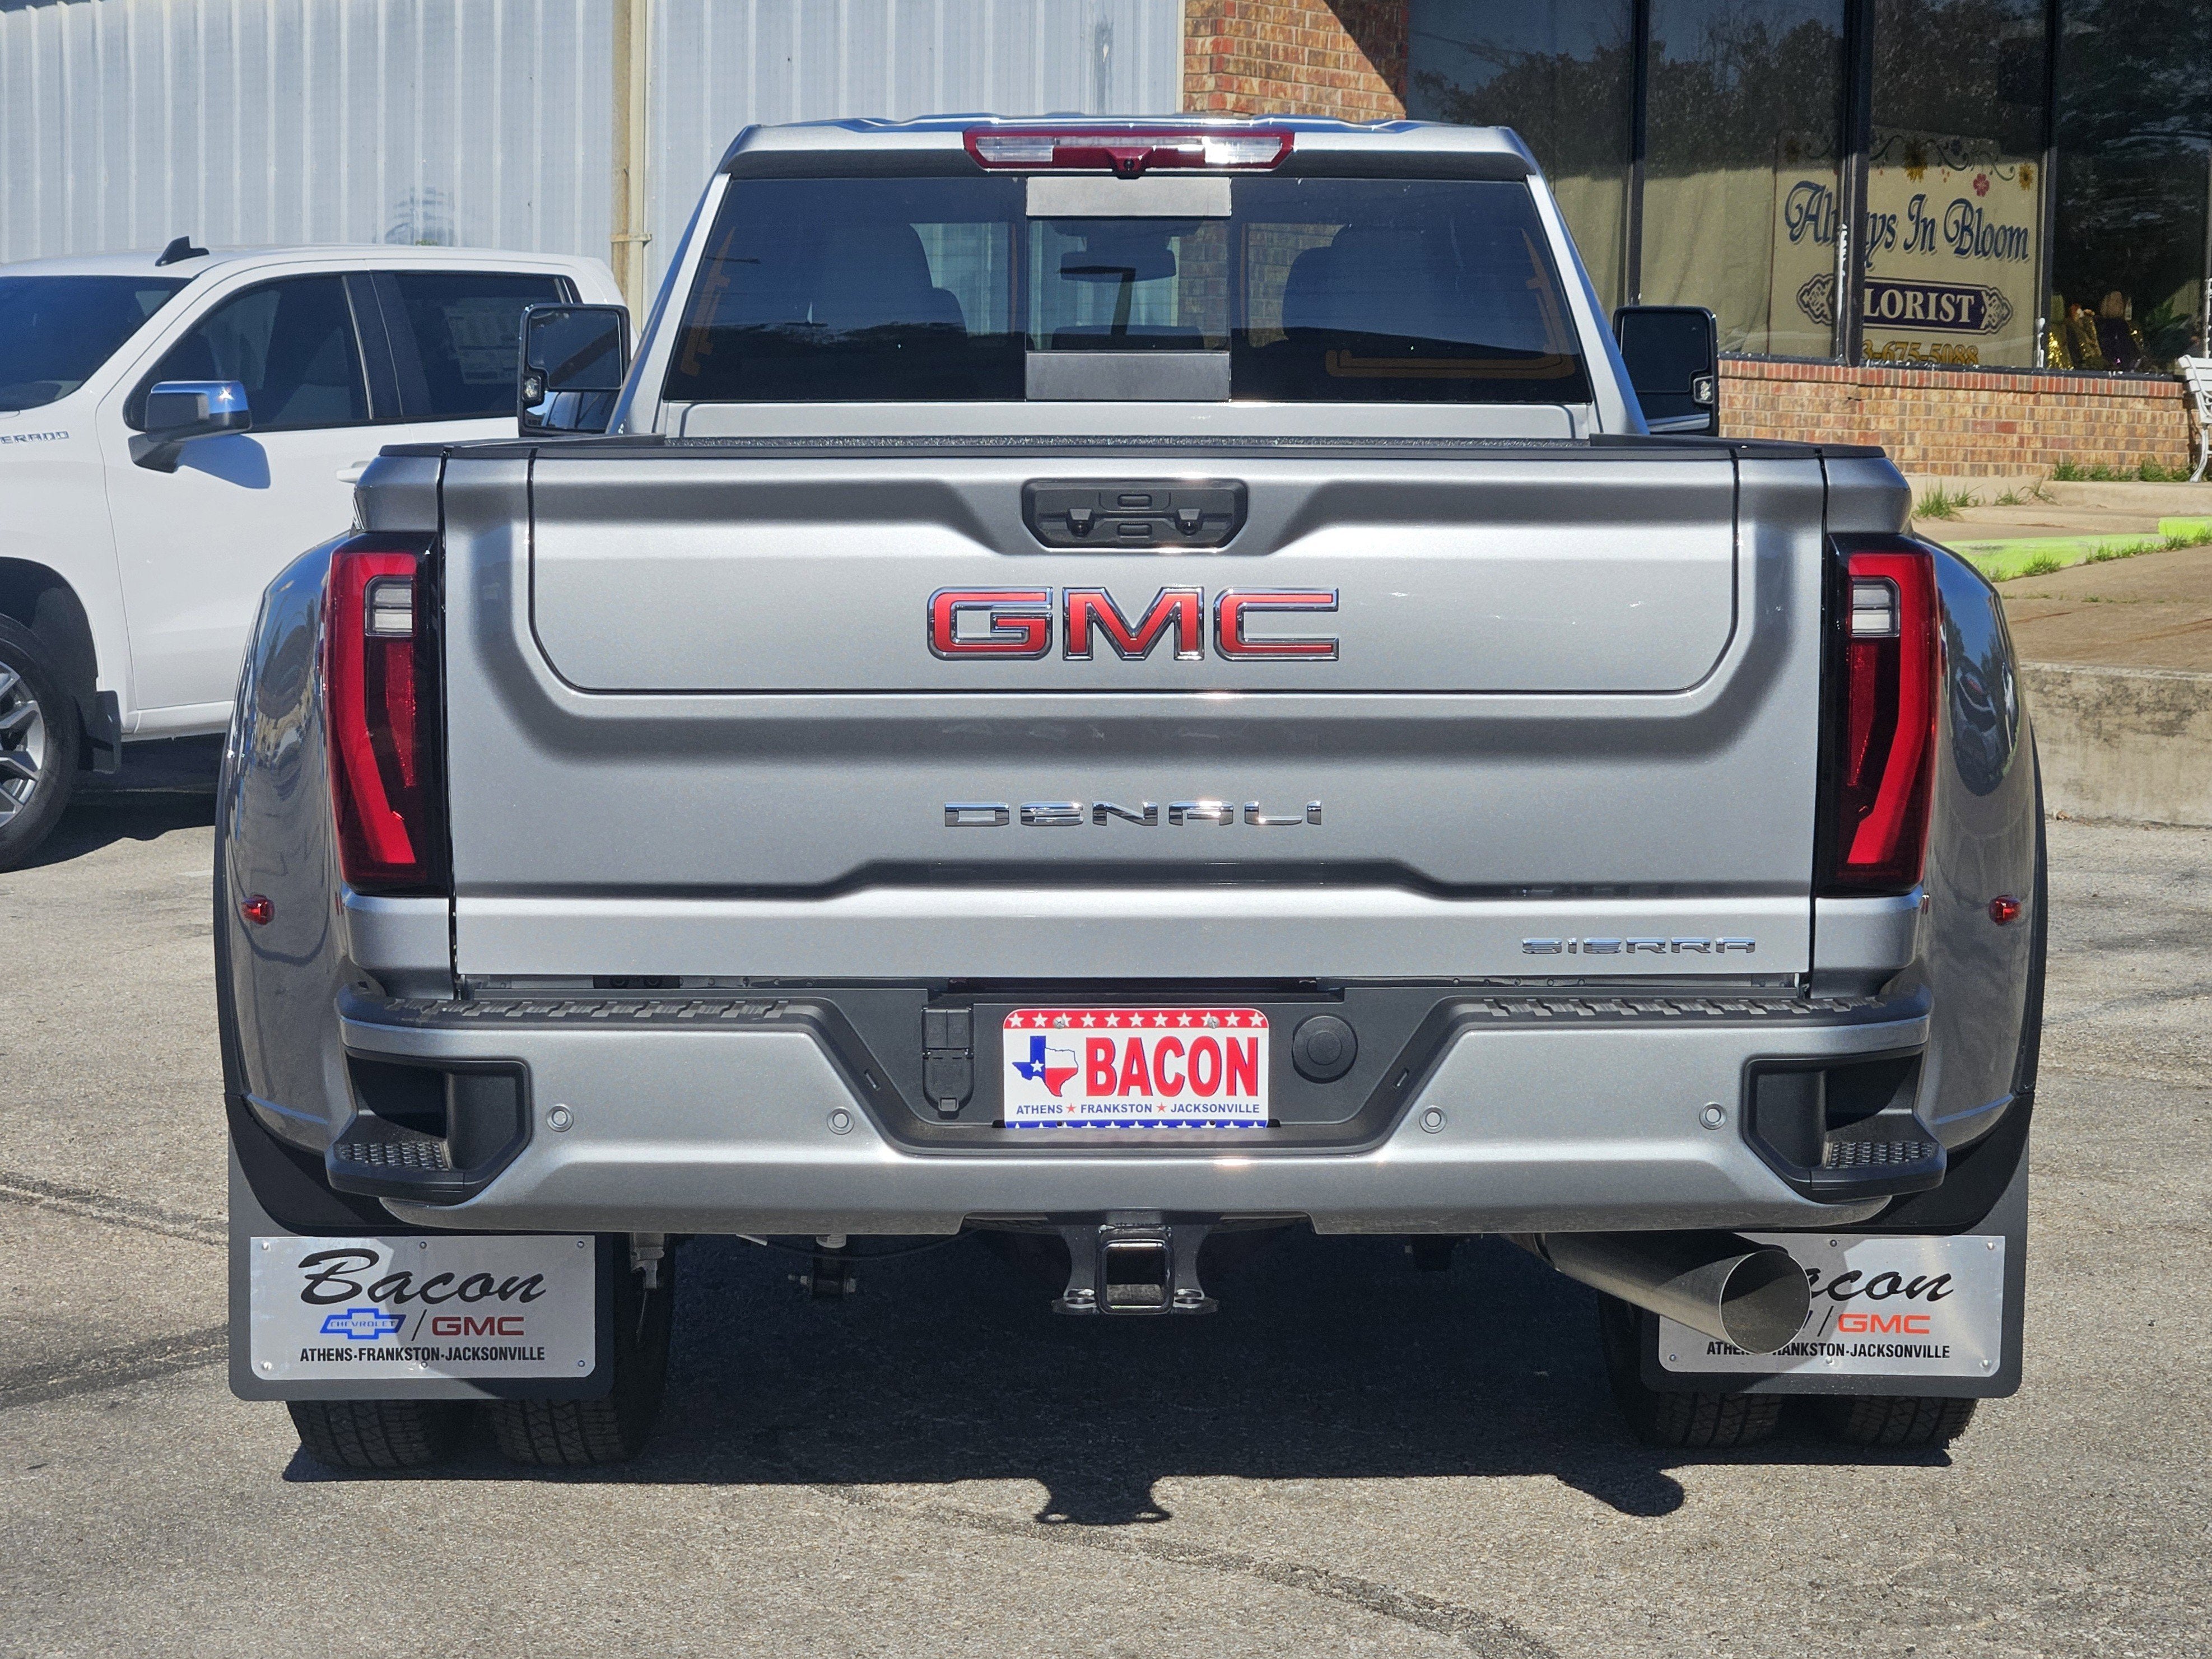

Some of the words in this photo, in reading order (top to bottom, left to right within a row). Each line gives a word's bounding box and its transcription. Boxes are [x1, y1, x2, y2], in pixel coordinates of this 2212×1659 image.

[1785, 180, 1897, 269] Alys
[1903, 194, 1936, 253] In
[1944, 198, 2030, 262] Bloom
[1864, 288, 1974, 323] LORIST
[1862, 339, 1979, 365] 3-675-5088
[927, 586, 1339, 661] GMC
[944, 800, 1322, 827] DENALI
[1521, 936, 1756, 954] SIERRA
[1086, 1035, 1259, 1097] BACON
[1016, 1104, 1064, 1115] ATHENS
[1080, 1103, 1153, 1114] FRANKSTON
[1170, 1103, 1260, 1113] JACKSONVILLE
[298, 1248, 547, 1305] Bacon
[1805, 1267, 1954, 1302] con
[431, 1316, 524, 1336] GMC
[1838, 1313, 1931, 1335] GMC
